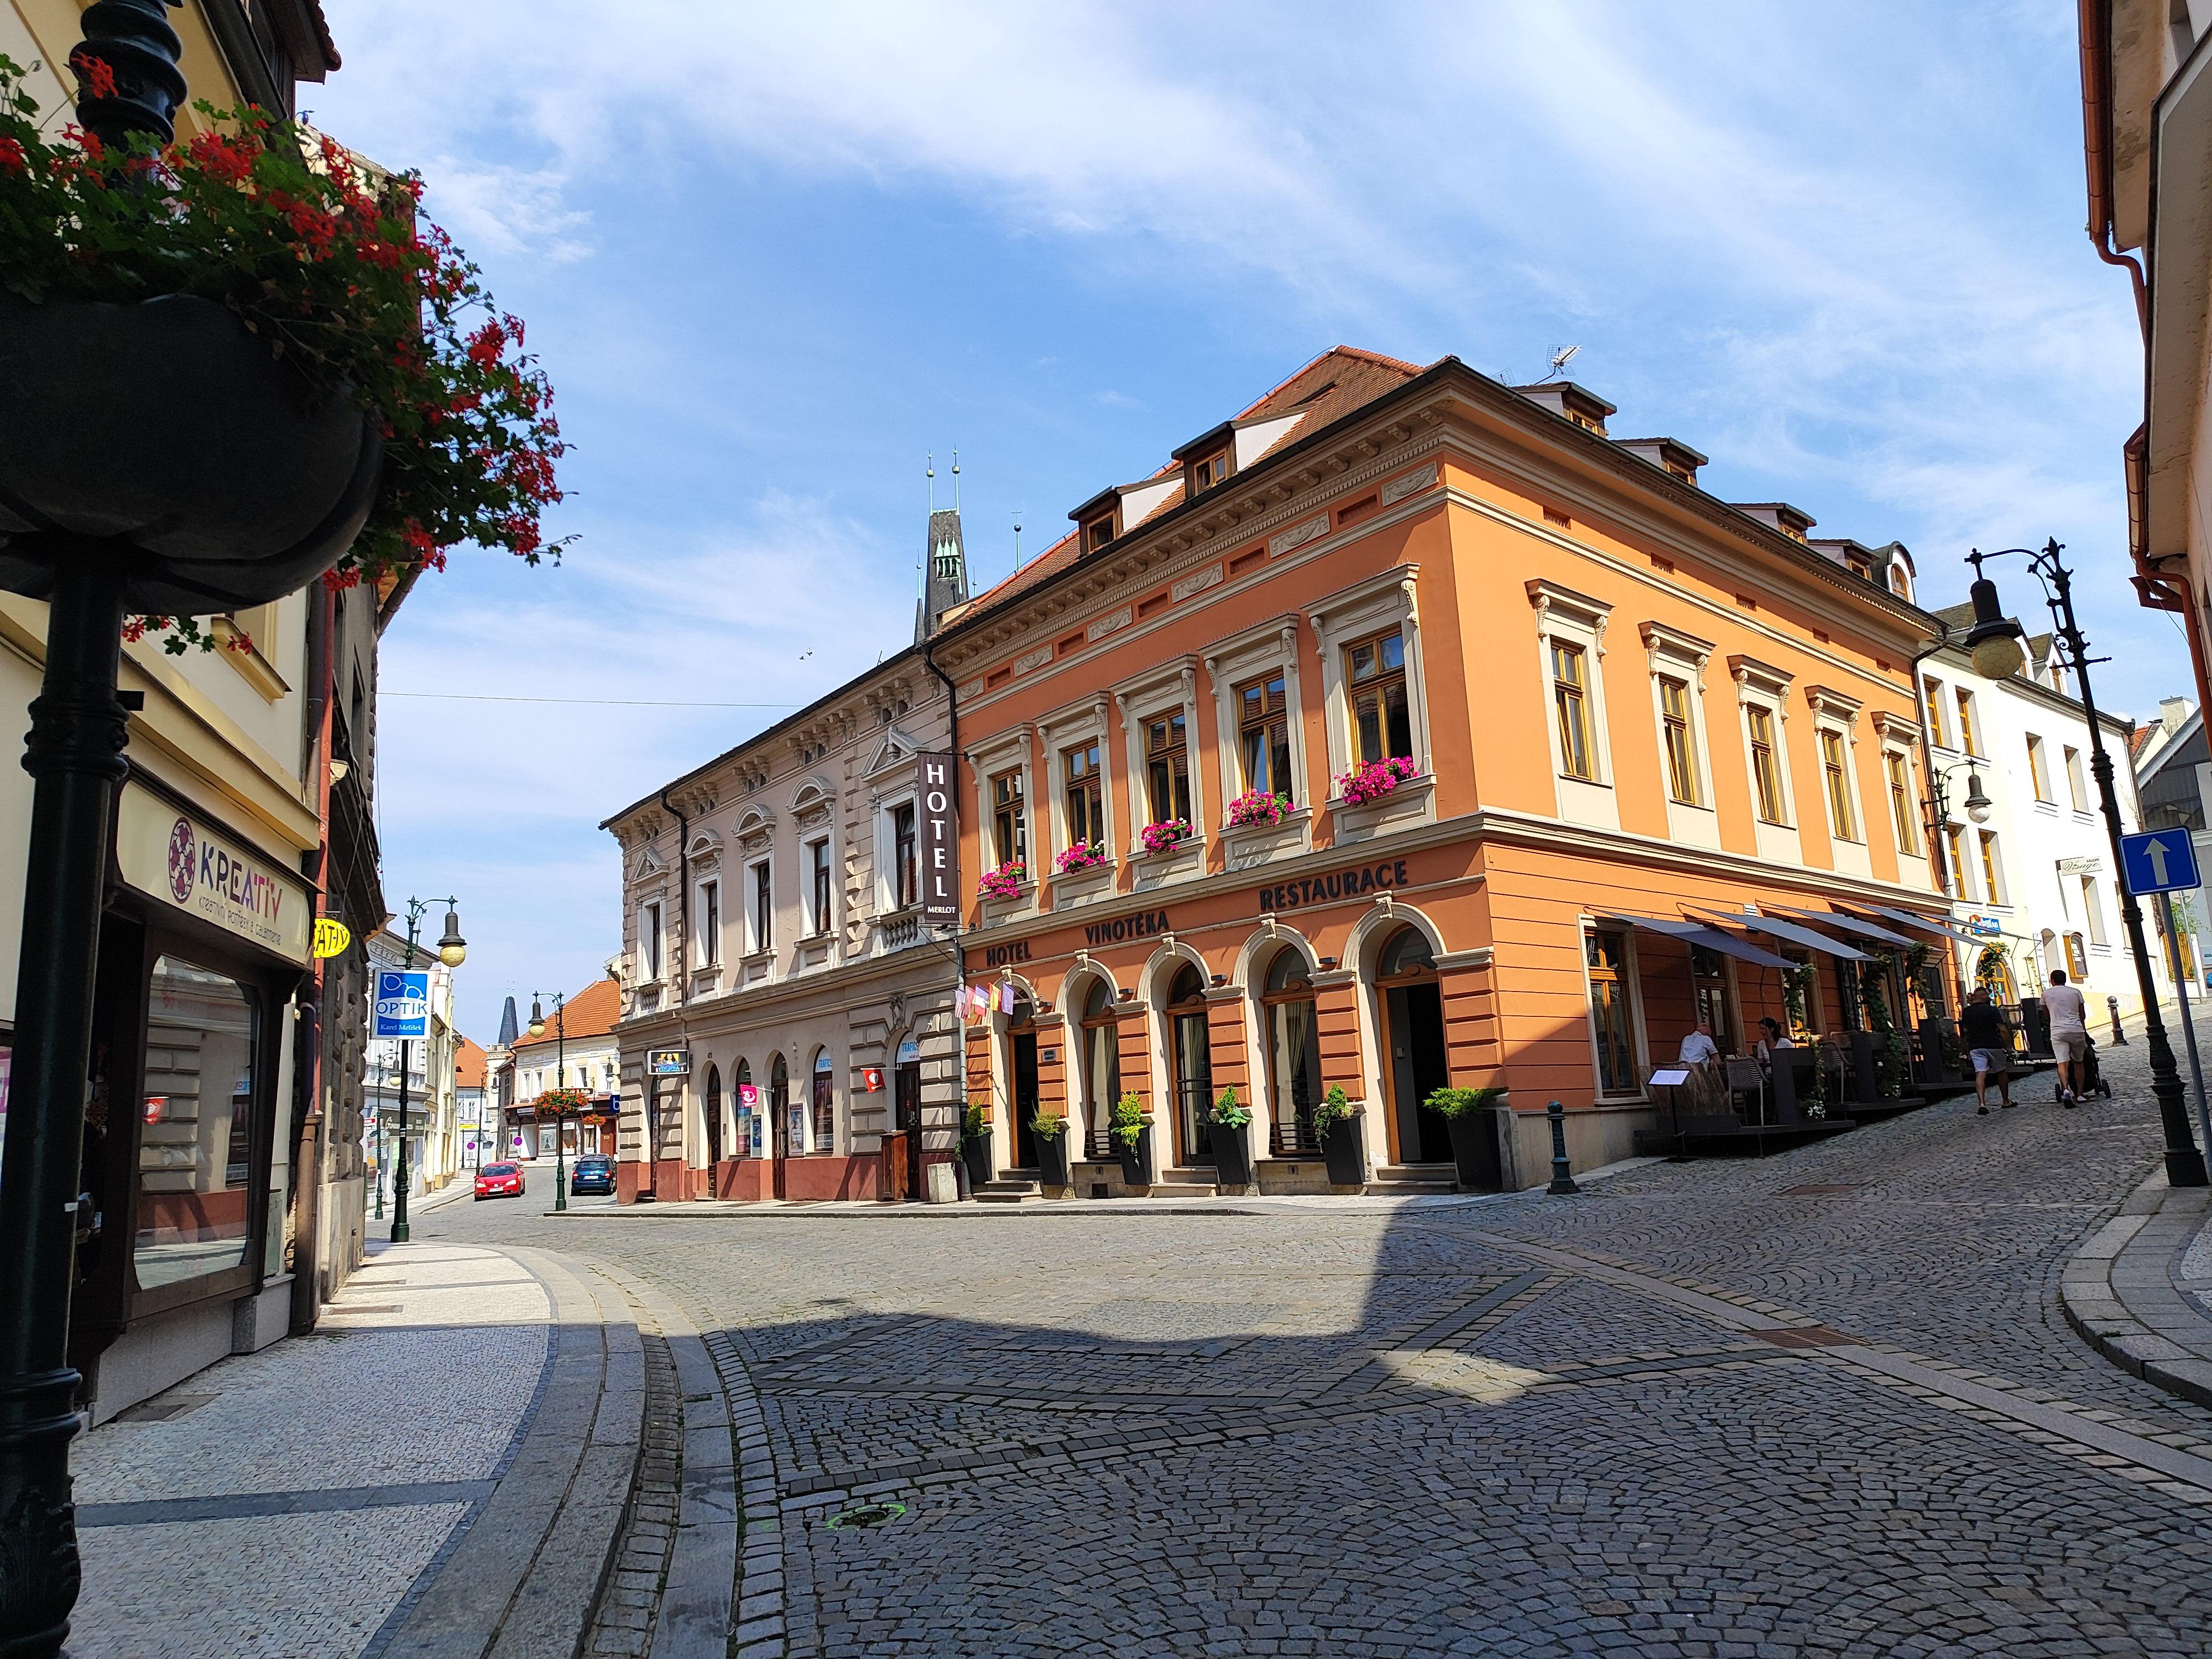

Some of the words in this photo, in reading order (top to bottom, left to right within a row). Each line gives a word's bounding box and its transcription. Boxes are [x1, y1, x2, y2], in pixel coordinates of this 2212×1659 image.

[926, 764, 947, 897] HOTEL
[200, 841, 283, 924] KREATIV
[1260, 860, 1408, 911] RESTAURACE
[927, 905, 956, 914] MERLOT
[314, 924, 348, 953] ATIV
[1084, 911, 1170, 945] VINOTÉKA
[986, 941, 1032, 967] HOTEL
[375, 1002, 428, 1014] OPTIK
